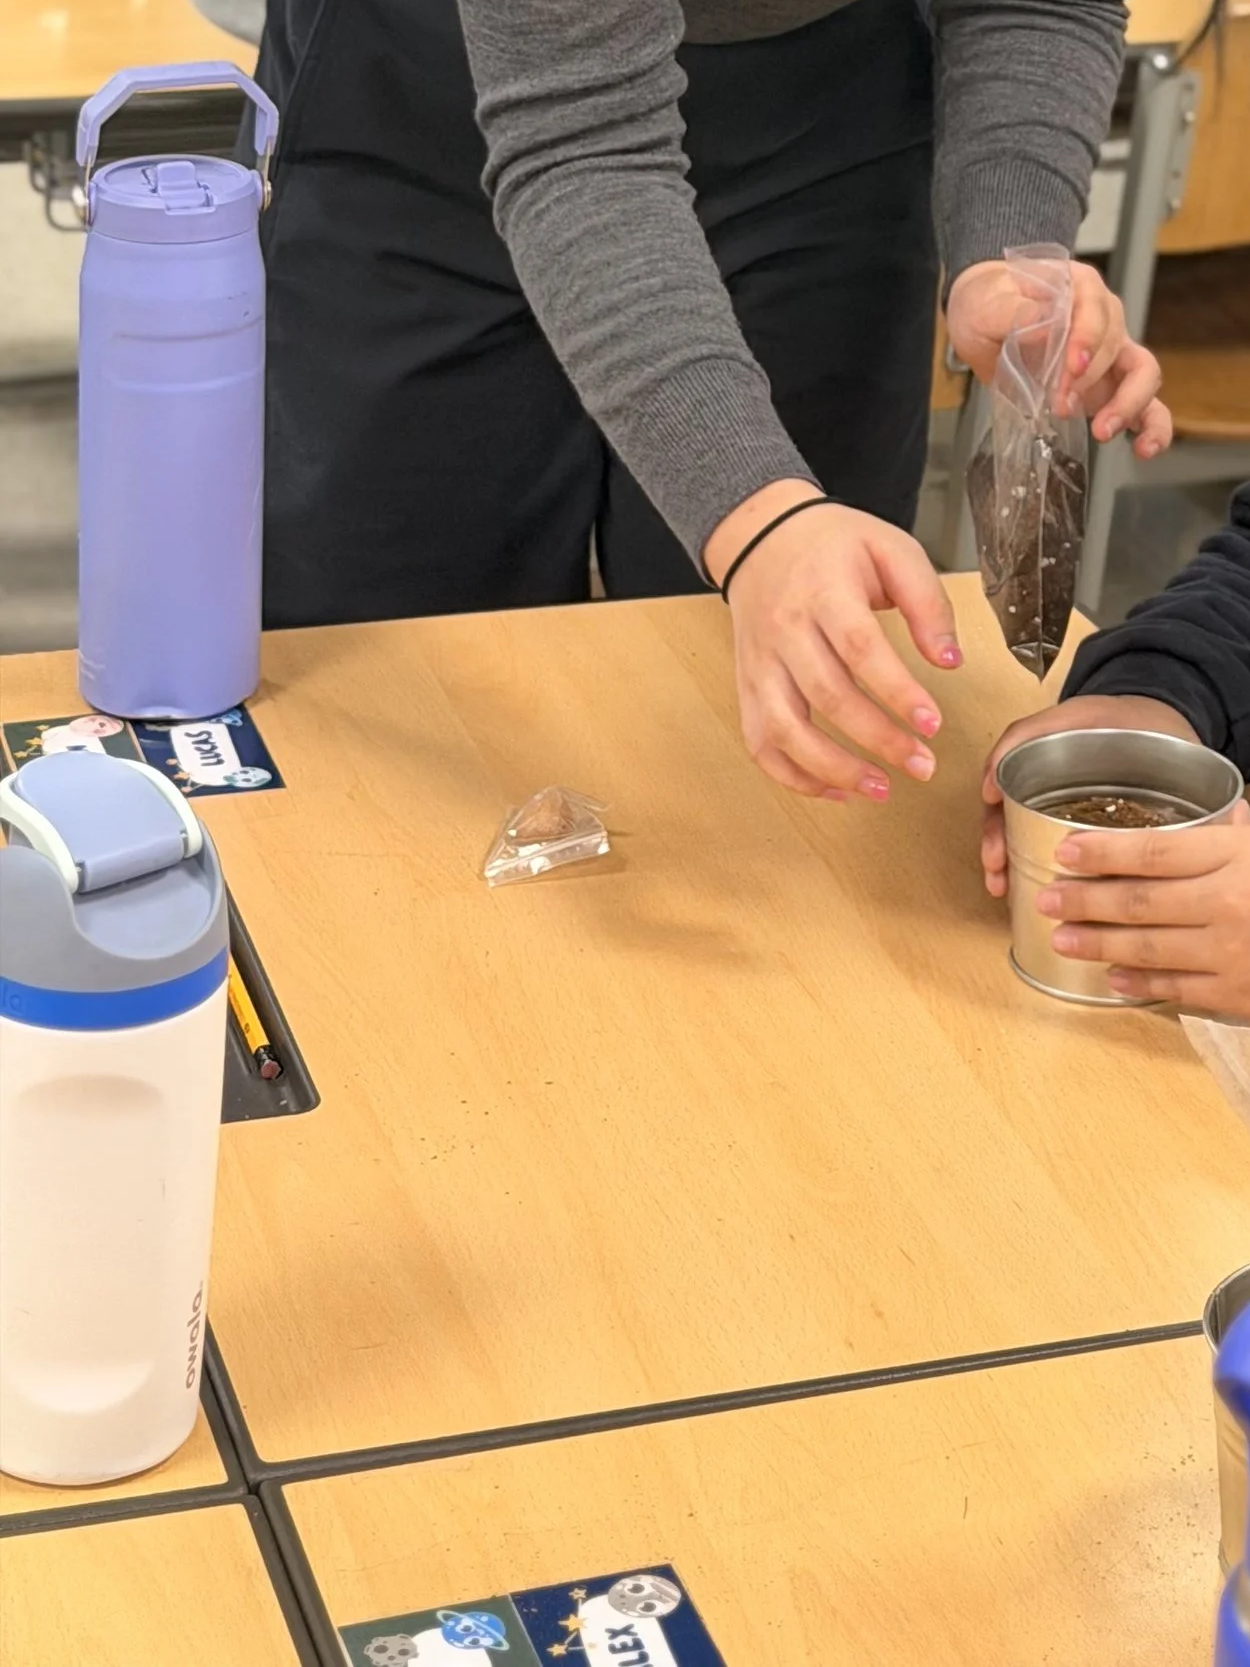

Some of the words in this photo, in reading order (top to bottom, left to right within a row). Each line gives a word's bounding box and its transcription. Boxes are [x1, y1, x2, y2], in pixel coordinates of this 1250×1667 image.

[184, 730, 225, 767] LUCAS
[185, 1287, 203, 1390] owala
[604, 1622, 654, 1667] LEX
